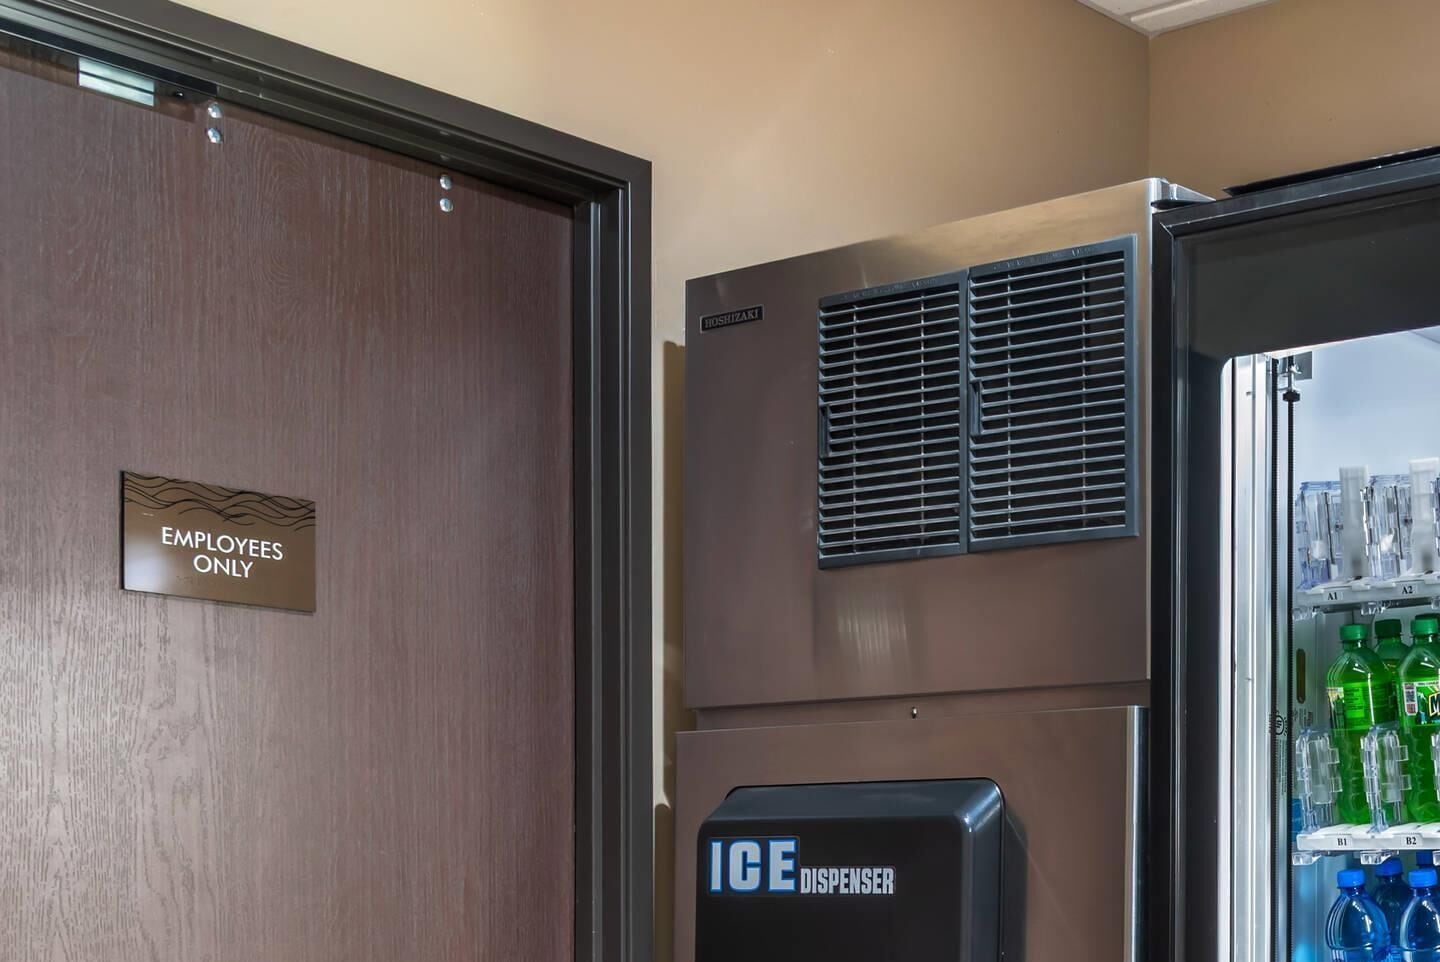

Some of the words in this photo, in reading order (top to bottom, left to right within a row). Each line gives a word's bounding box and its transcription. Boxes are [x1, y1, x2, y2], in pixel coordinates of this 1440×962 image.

[704, 308, 759, 328] HOSHIZAKI
[161, 526, 284, 560] EMPLOYEES
[193, 554, 254, 578] ONLY
[1328, 592, 1338, 600] A1
[1402, 586, 1412, 594] A2
[1338, 838, 1348, 846] B1
[1406, 836, 1416, 845] B2
[710, 839, 797, 892] ICE
[800, 867, 895, 895] DISPENSER
